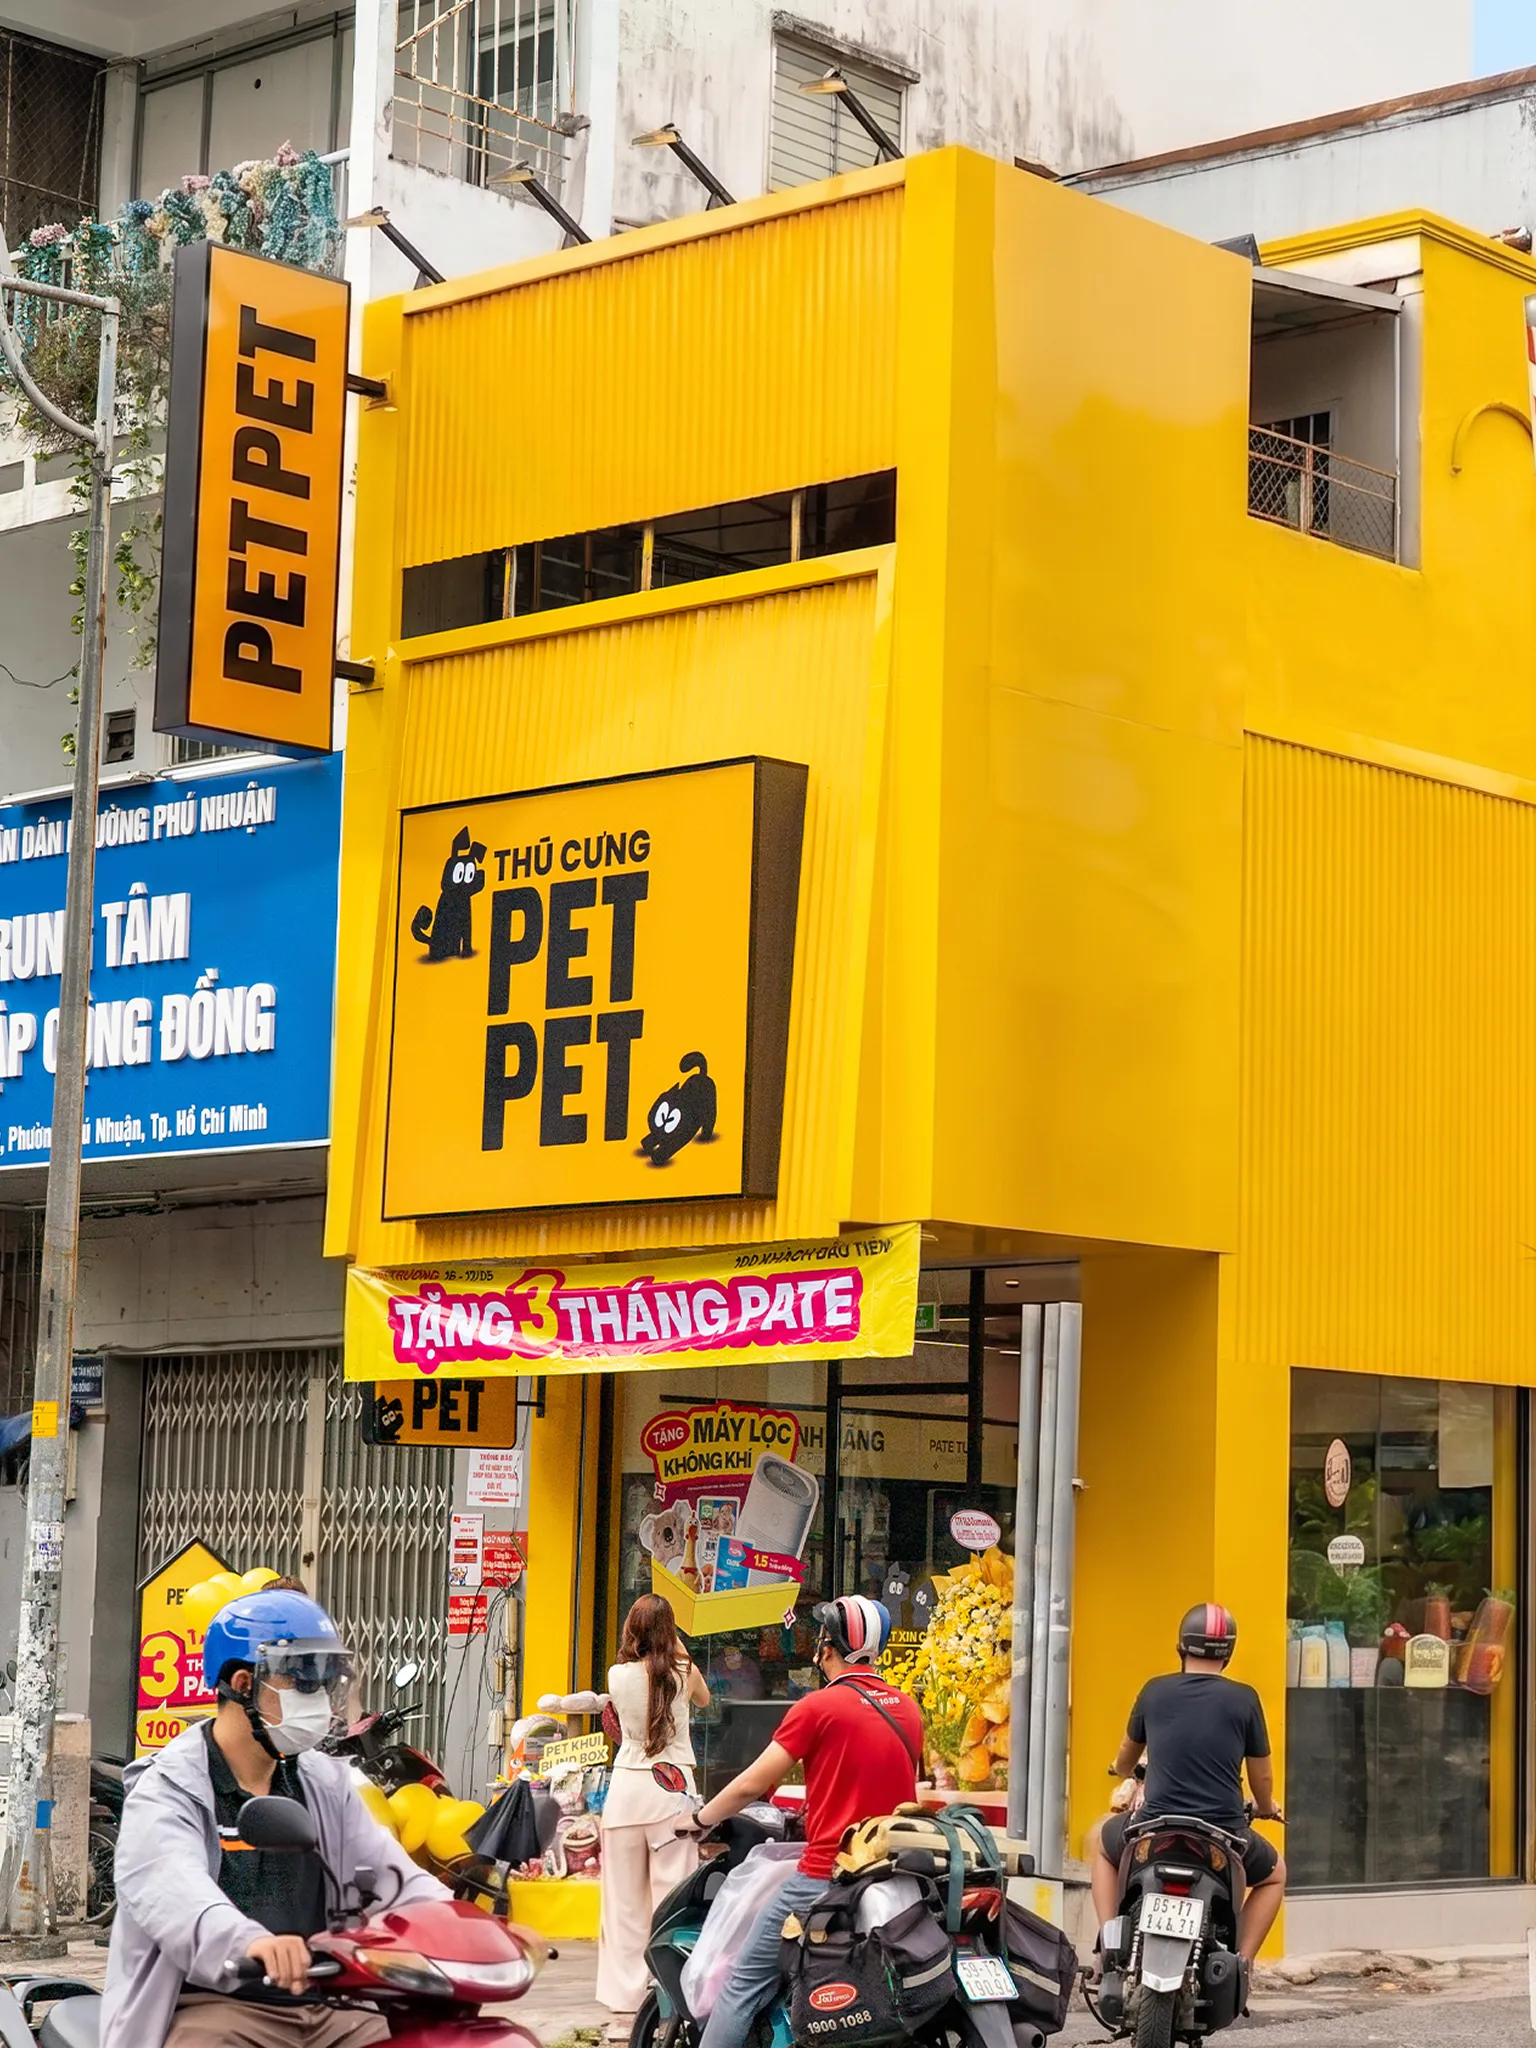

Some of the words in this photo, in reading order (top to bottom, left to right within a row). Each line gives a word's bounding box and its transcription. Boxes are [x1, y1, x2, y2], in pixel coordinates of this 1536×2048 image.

[223, 304, 316, 694] PETPET
[22, 816, 63, 859] DÂN
[67, 803, 150, 852] ƯỜNG
[153, 790, 197, 840] PHÚ
[201, 781, 276, 834] NHUẬN
[560, 829, 651, 872] CƯNG
[102, 882, 191, 968] TÂM
[487, 871, 649, 1016] PET
[160, 968, 275, 1062] ĐỒNG
[481, 1009, 644, 1151] PET
[8, 1121, 52, 1152] Phườn
[96, 1114, 145, 1147] Nhuận,
[151, 1113, 172, 1142] Tp.
[177, 1105, 197, 1137] Hồ
[201, 1107, 226, 1134] Chí
[229, 1103, 268, 1132] Minh
[758, 1247, 816, 1265] KHÁCH
[395, 1292, 514, 1359] TẶNG
[515, 1275, 559, 1346] 3
[558, 1282, 729, 1344] THÁNG
[731, 1276, 854, 1332] PATE
[412, 1379, 485, 1432] PET
[653, 1427, 685, 1447] TẶNG
[694, 1411, 746, 1444] MÁY
[750, 1419, 792, 1448] LỌC
[929, 1439, 954, 1453] PATE
[664, 1450, 723, 1478] KHÔNG
[725, 1448, 752, 1471] KHÍ
[753, 1553, 769, 1568] 1.5
[167, 1588, 188, 1605] PE
[899, 1631, 917, 1642] XIN
[140, 1636, 181, 1698] 3
[146, 1720, 180, 1739] 100
[546, 1743, 568, 1757] PET
[571, 1736, 601, 1752] KHUI
[580, 1748, 606, 1763] BOX
[807, 2019, 838, 2034] 1900
[839, 2010, 872, 2028] 1088
